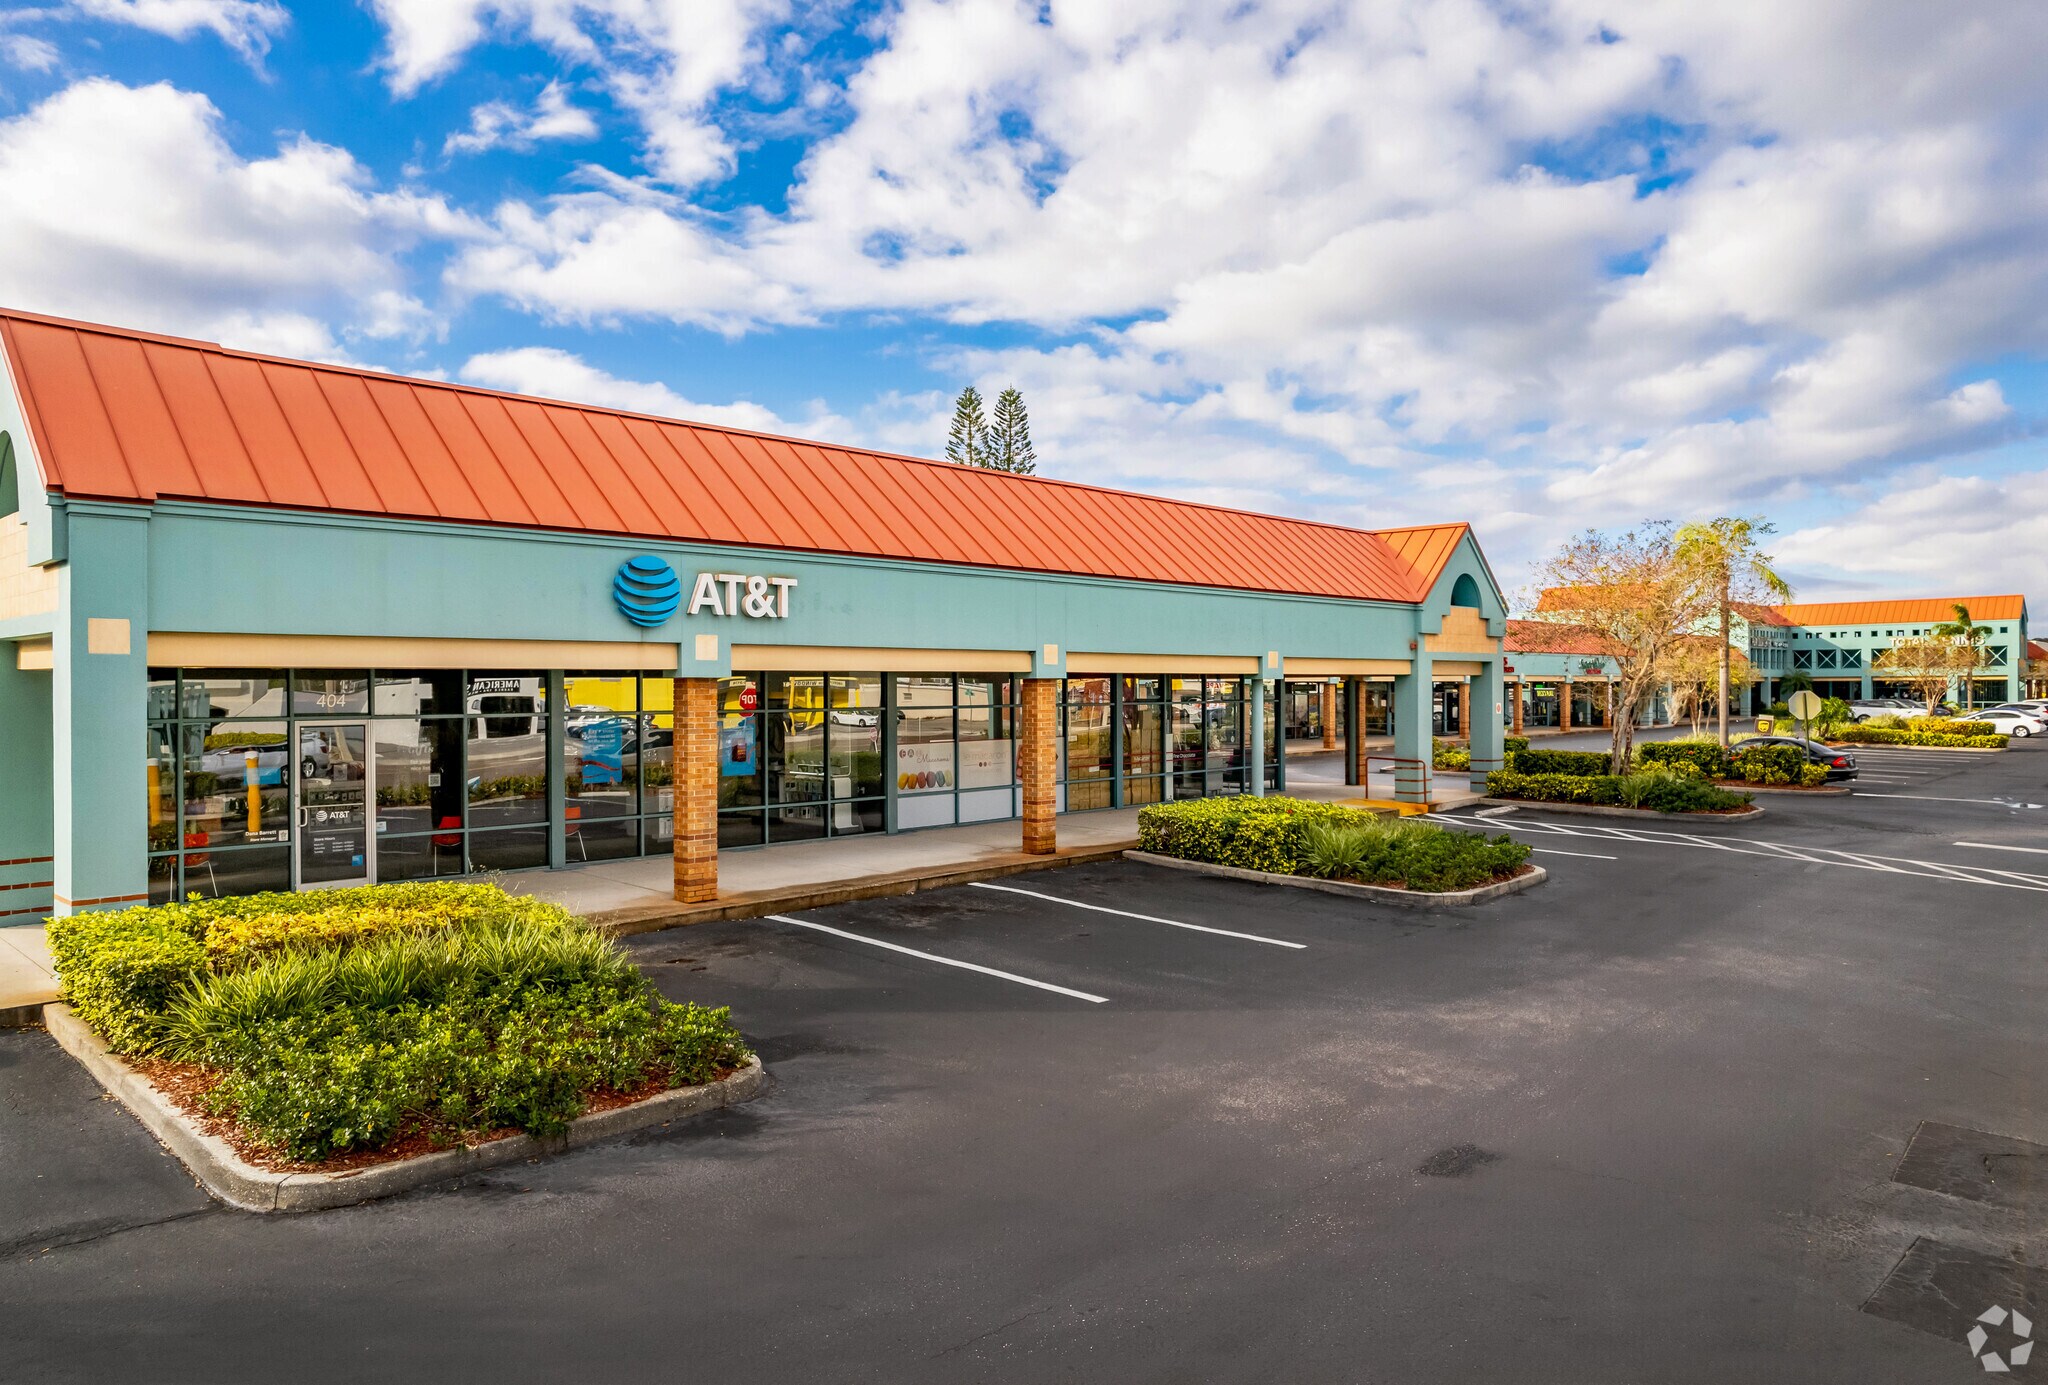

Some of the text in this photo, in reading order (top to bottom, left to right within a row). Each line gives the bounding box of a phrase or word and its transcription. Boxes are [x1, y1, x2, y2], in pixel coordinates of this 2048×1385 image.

[686, 573, 798, 618] AT&T
[316, 694, 346, 708] 404
[329, 811, 350, 819] AT&T
